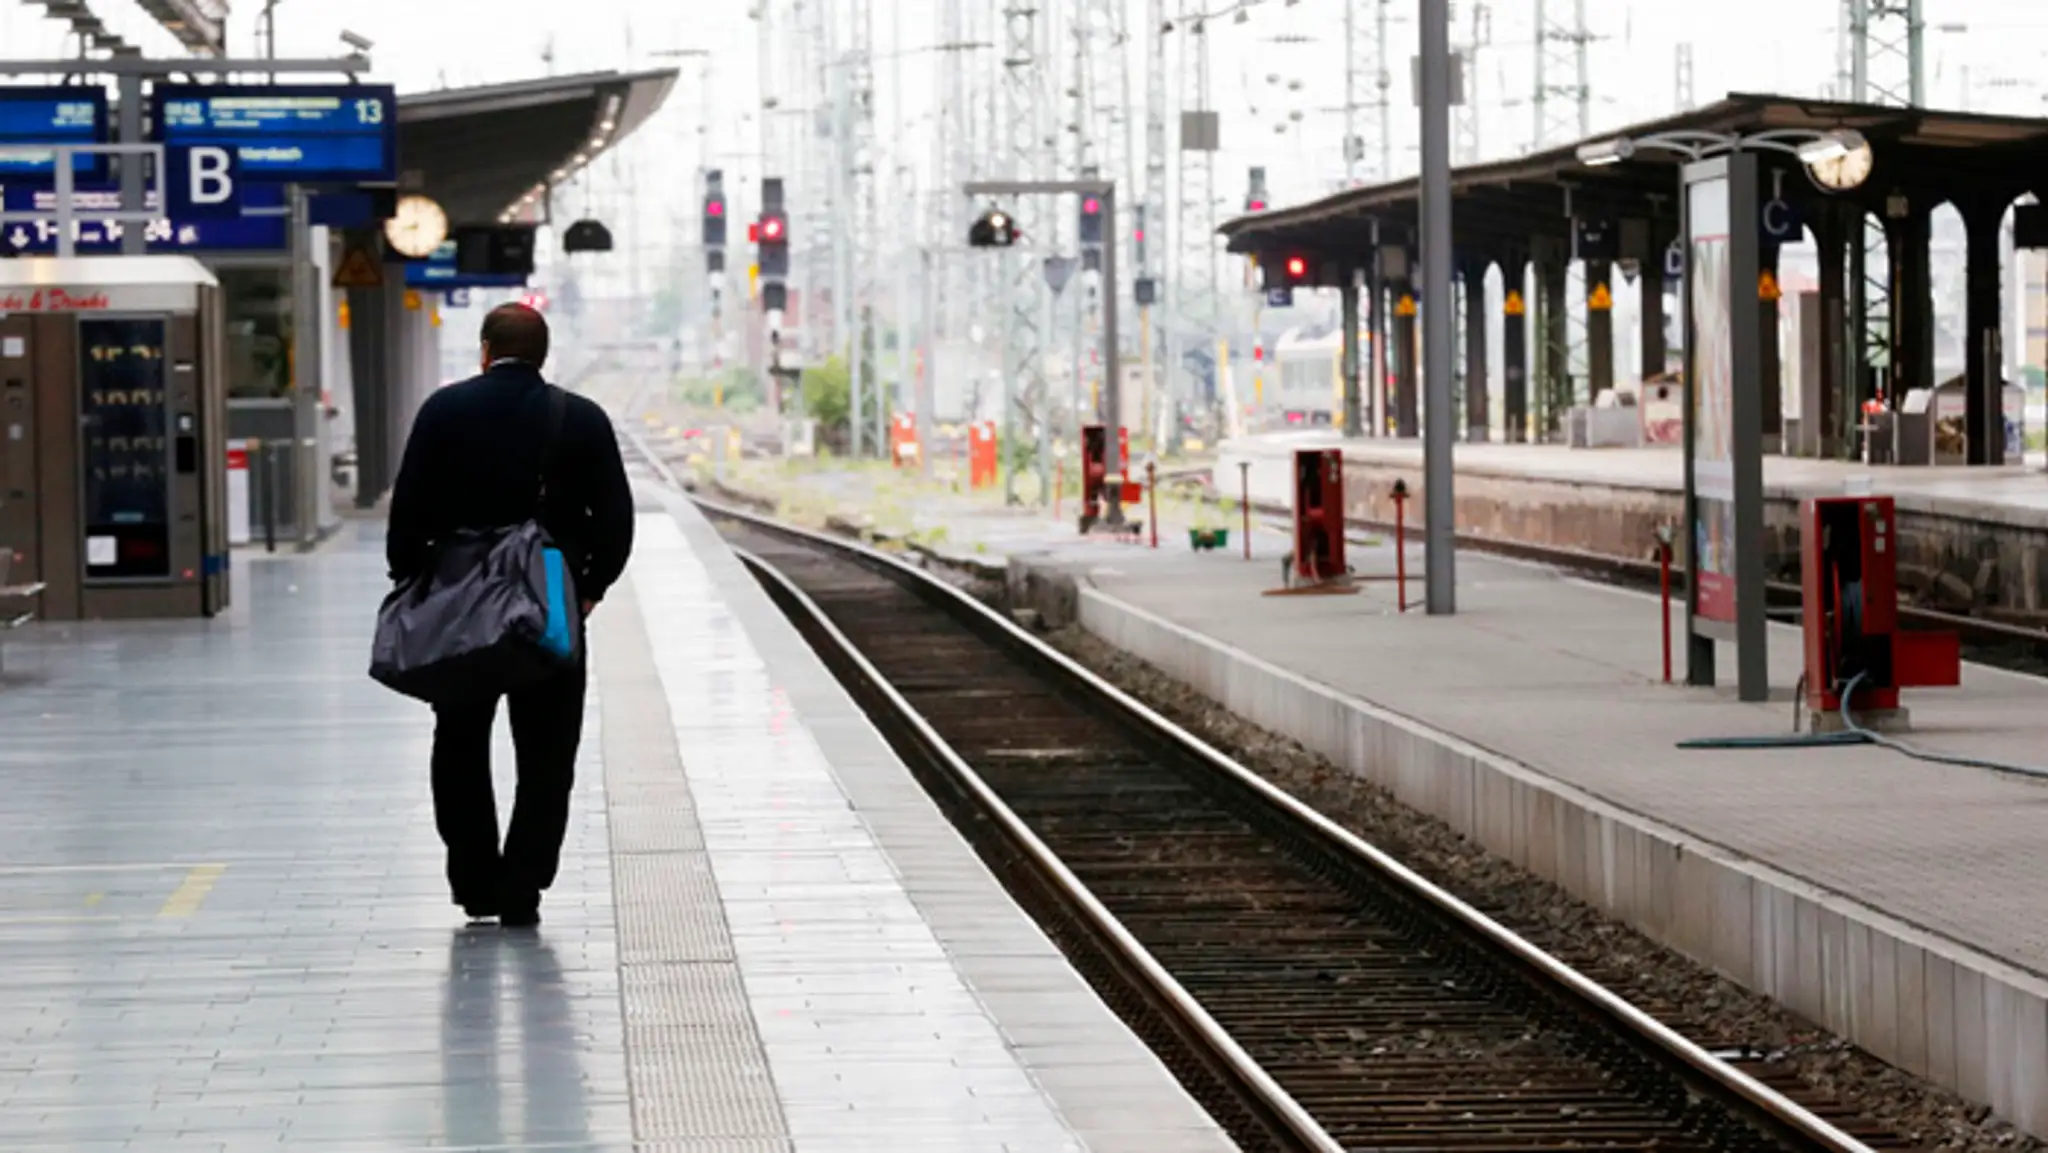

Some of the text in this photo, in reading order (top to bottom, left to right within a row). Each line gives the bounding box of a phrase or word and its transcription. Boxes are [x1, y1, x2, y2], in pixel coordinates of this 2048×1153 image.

[355, 100, 384, 123] 13
[190, 147, 233, 204] B
[1763, 199, 1789, 236] C
[48, 287, 109, 309] Drinks
